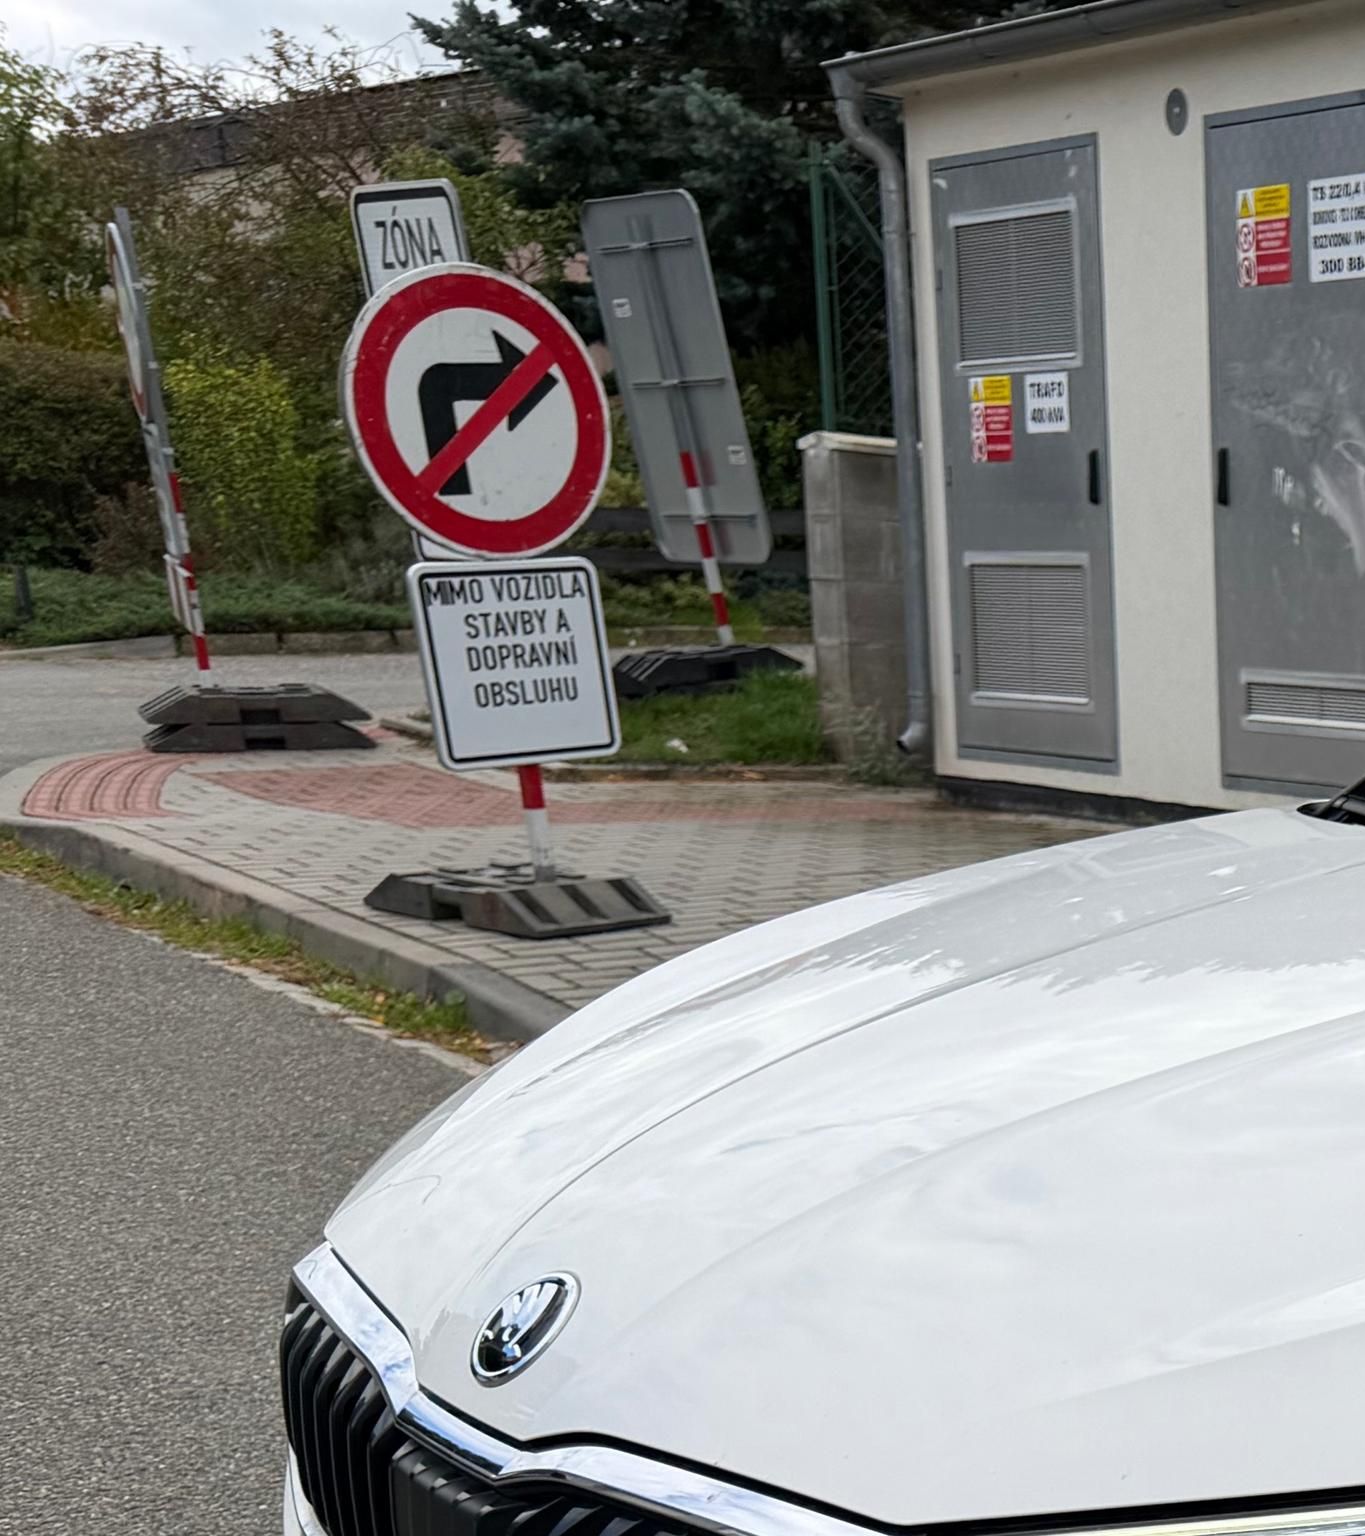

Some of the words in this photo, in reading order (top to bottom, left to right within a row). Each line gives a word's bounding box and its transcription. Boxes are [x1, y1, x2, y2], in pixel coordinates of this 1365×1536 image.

[373, 205, 447, 270] ZÓNA
[490, 572, 586, 603] VOZIDLA
[464, 608, 548, 640] STAVBY
[556, 607, 572, 635] A
[466, 635, 578, 672] DOPRAVNÍ
[473, 675, 579, 709] OBSLUHU
